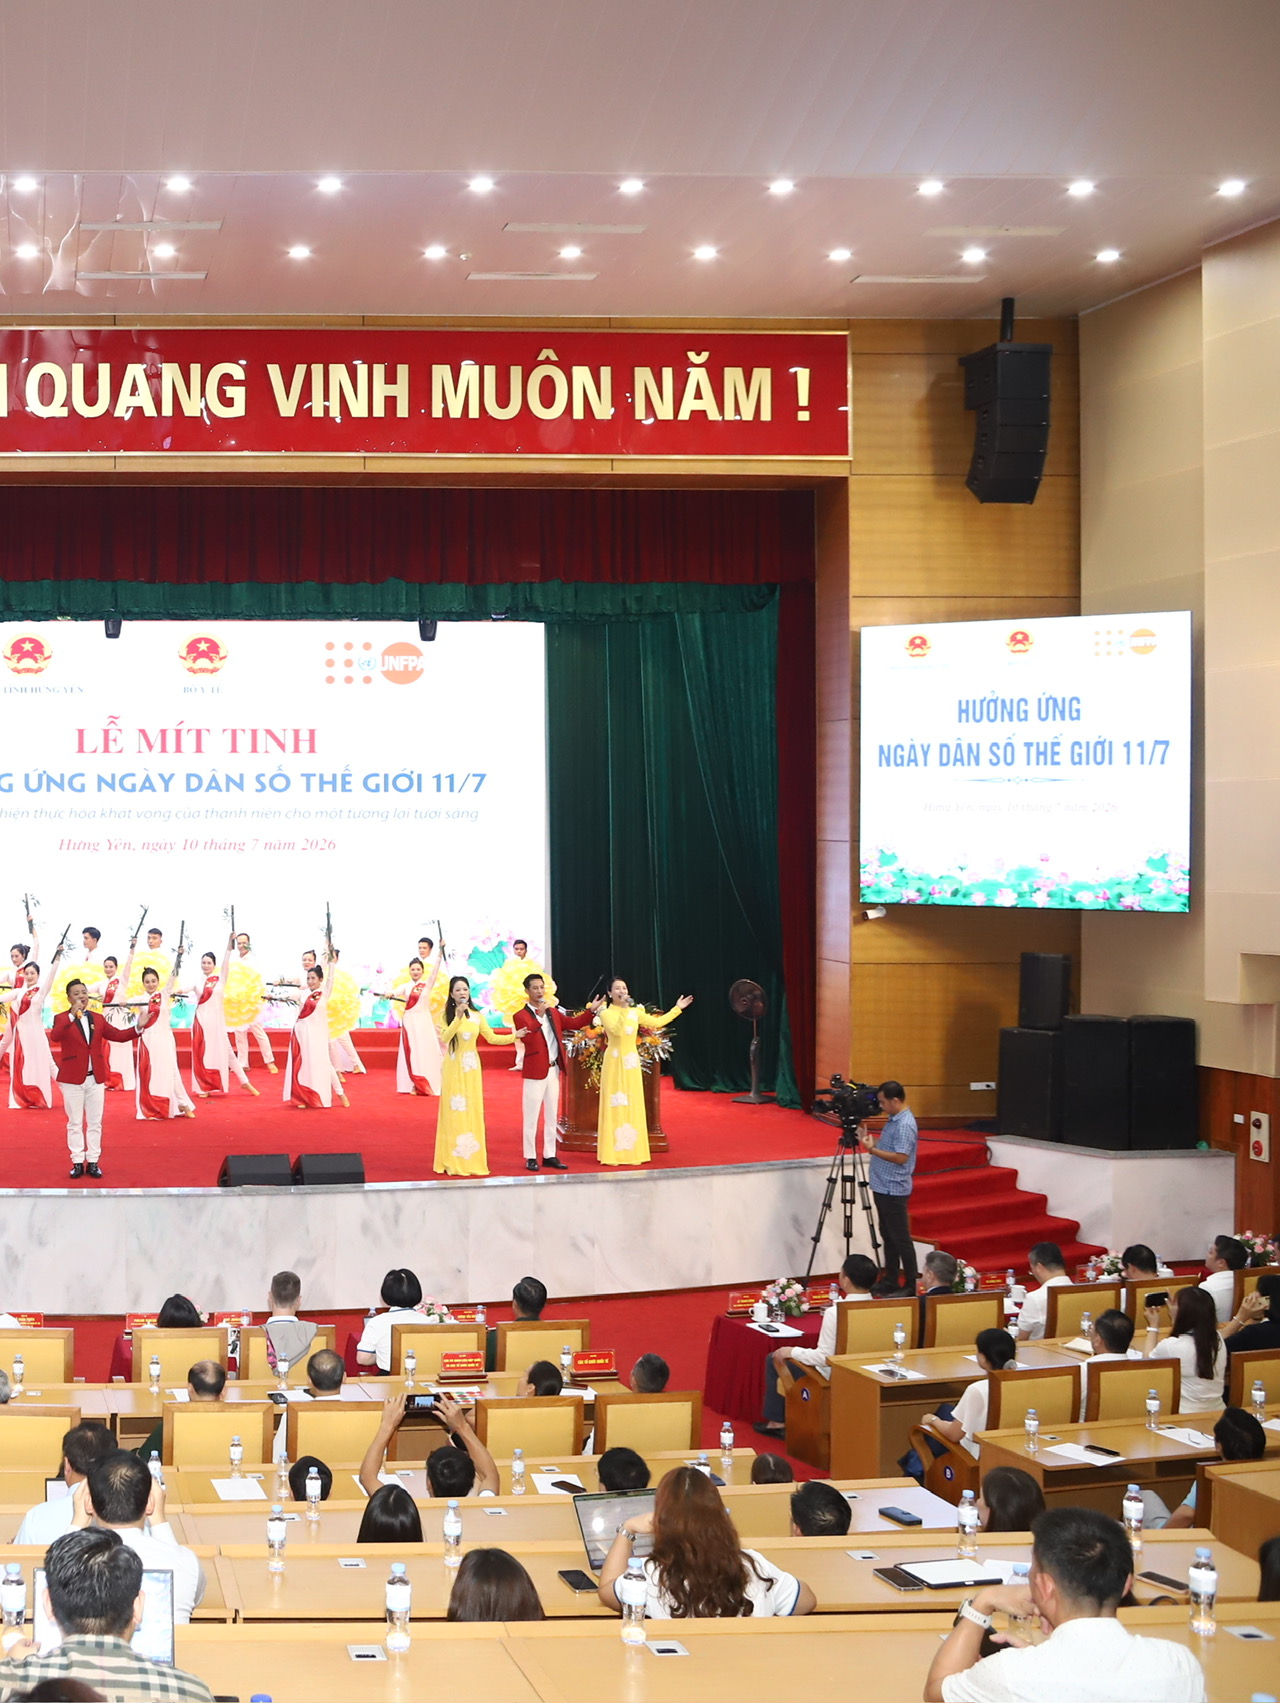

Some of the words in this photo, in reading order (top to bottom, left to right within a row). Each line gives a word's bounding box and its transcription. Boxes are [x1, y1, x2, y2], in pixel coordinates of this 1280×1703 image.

[24, 361, 246, 420] QUANG
[266, 362, 409, 419] VINH
[431, 348, 613, 421] MUÔN
[633, 351, 772, 422] NĂM
[793, 366, 811, 422] !
[957, 690, 1029, 724] HƯỞNG
[1036, 691, 1082, 722] ỨNG
[74, 714, 123, 755] LỄ
[135, 719, 211, 754] MÍT
[221, 728, 319, 754] TINH
[877, 738, 932, 768] NGÀY
[938, 737, 982, 768] DÂN
[988, 732, 1017, 767] SỐ
[1023, 732, 1064, 767] THẾ
[1070, 734, 1114, 767] GIỚI
[1122, 739, 1171, 767] 11/7
[23, 768, 86, 794] ỨNG
[96, 766, 176, 794] NGÀY
[185, 768, 246, 794] DÂN
[254, 764, 292, 794] SỐ
[299, 764, 353, 794] THẾ
[361, 766, 423, 794] GIỚI
[431, 772, 488, 795] 11/7
[136, 811, 172, 823] vọng
[175, 807, 201, 819] của
[204, 807, 247, 819] thanh
[251, 807, 282, 819] niên
[285, 807, 311, 819] cho
[393, 807, 410, 819] lai
[58, 839, 100, 853] Hưng
[106, 838, 136, 852] Yên,
[141, 840, 176, 854] ngày
[182, 838, 198, 851] 10
[203, 838, 246, 853] tháng
[251, 839, 259, 851] 7
[300, 838, 337, 851] 2026
